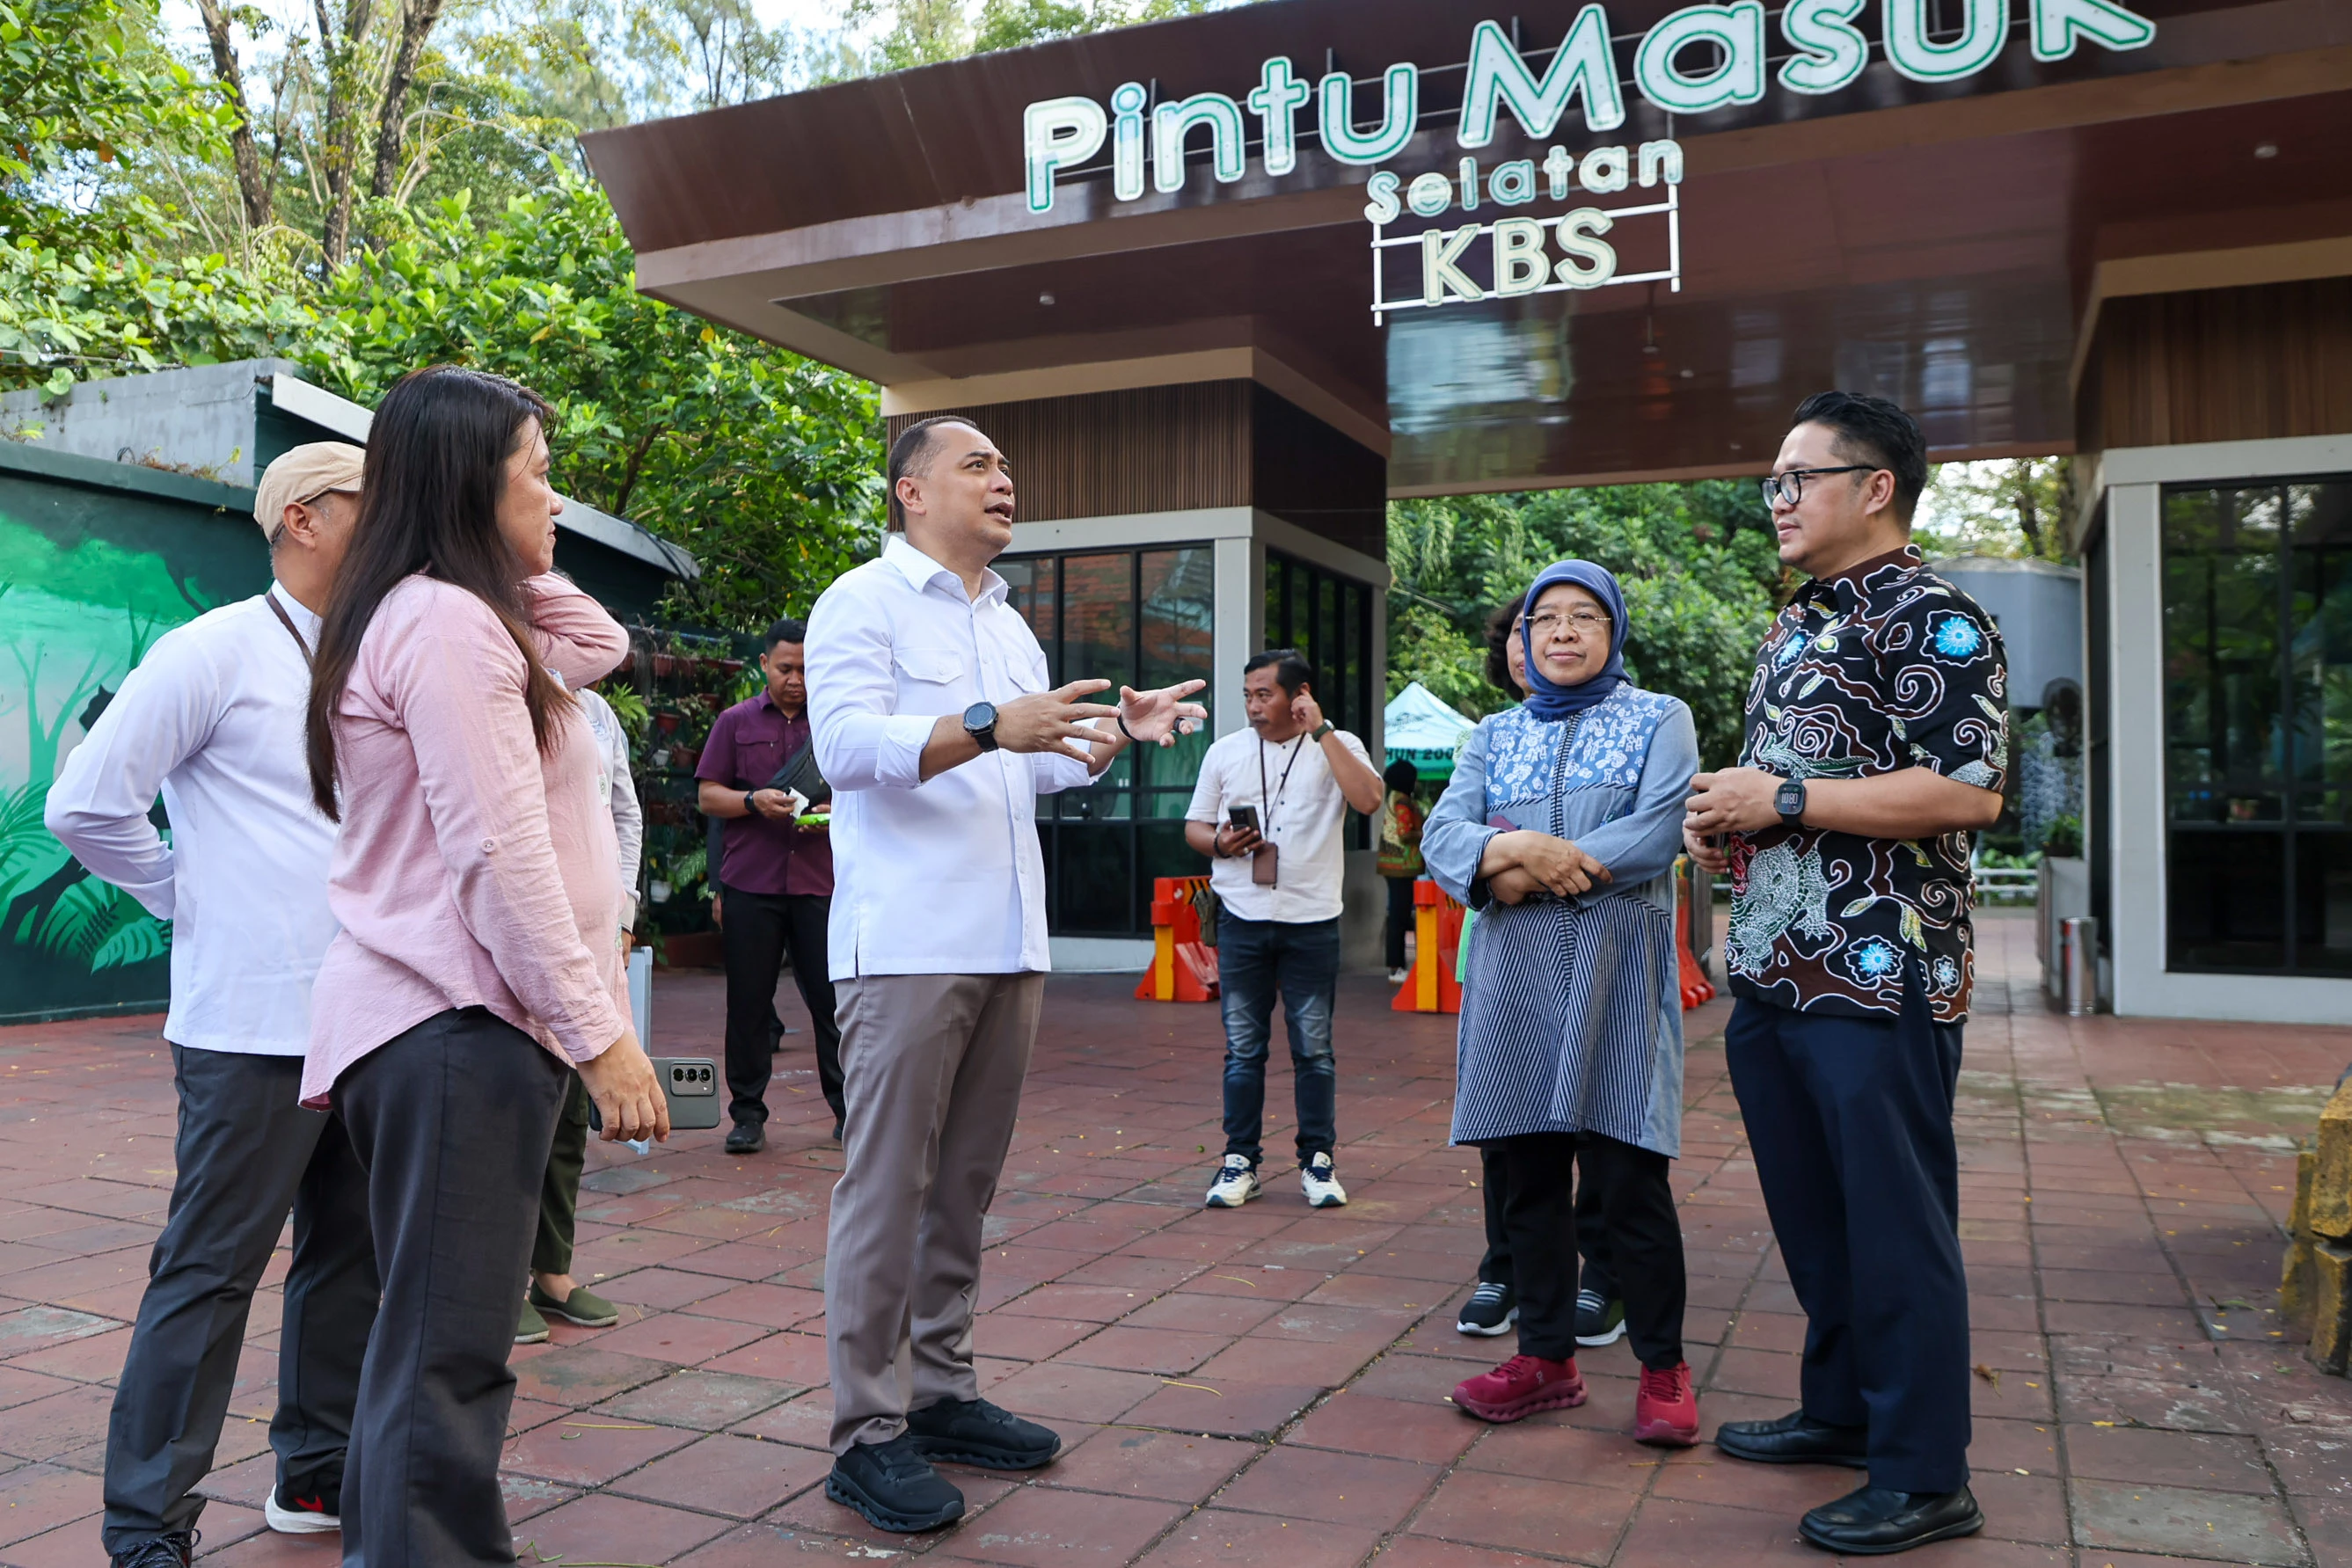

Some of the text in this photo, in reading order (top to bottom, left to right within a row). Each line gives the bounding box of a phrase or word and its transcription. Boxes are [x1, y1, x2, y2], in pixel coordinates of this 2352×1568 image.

[1024, 56, 1418, 213] Pintu
[1364, 139, 1684, 224] Selatan
[1422, 208, 1617, 306] KBS
